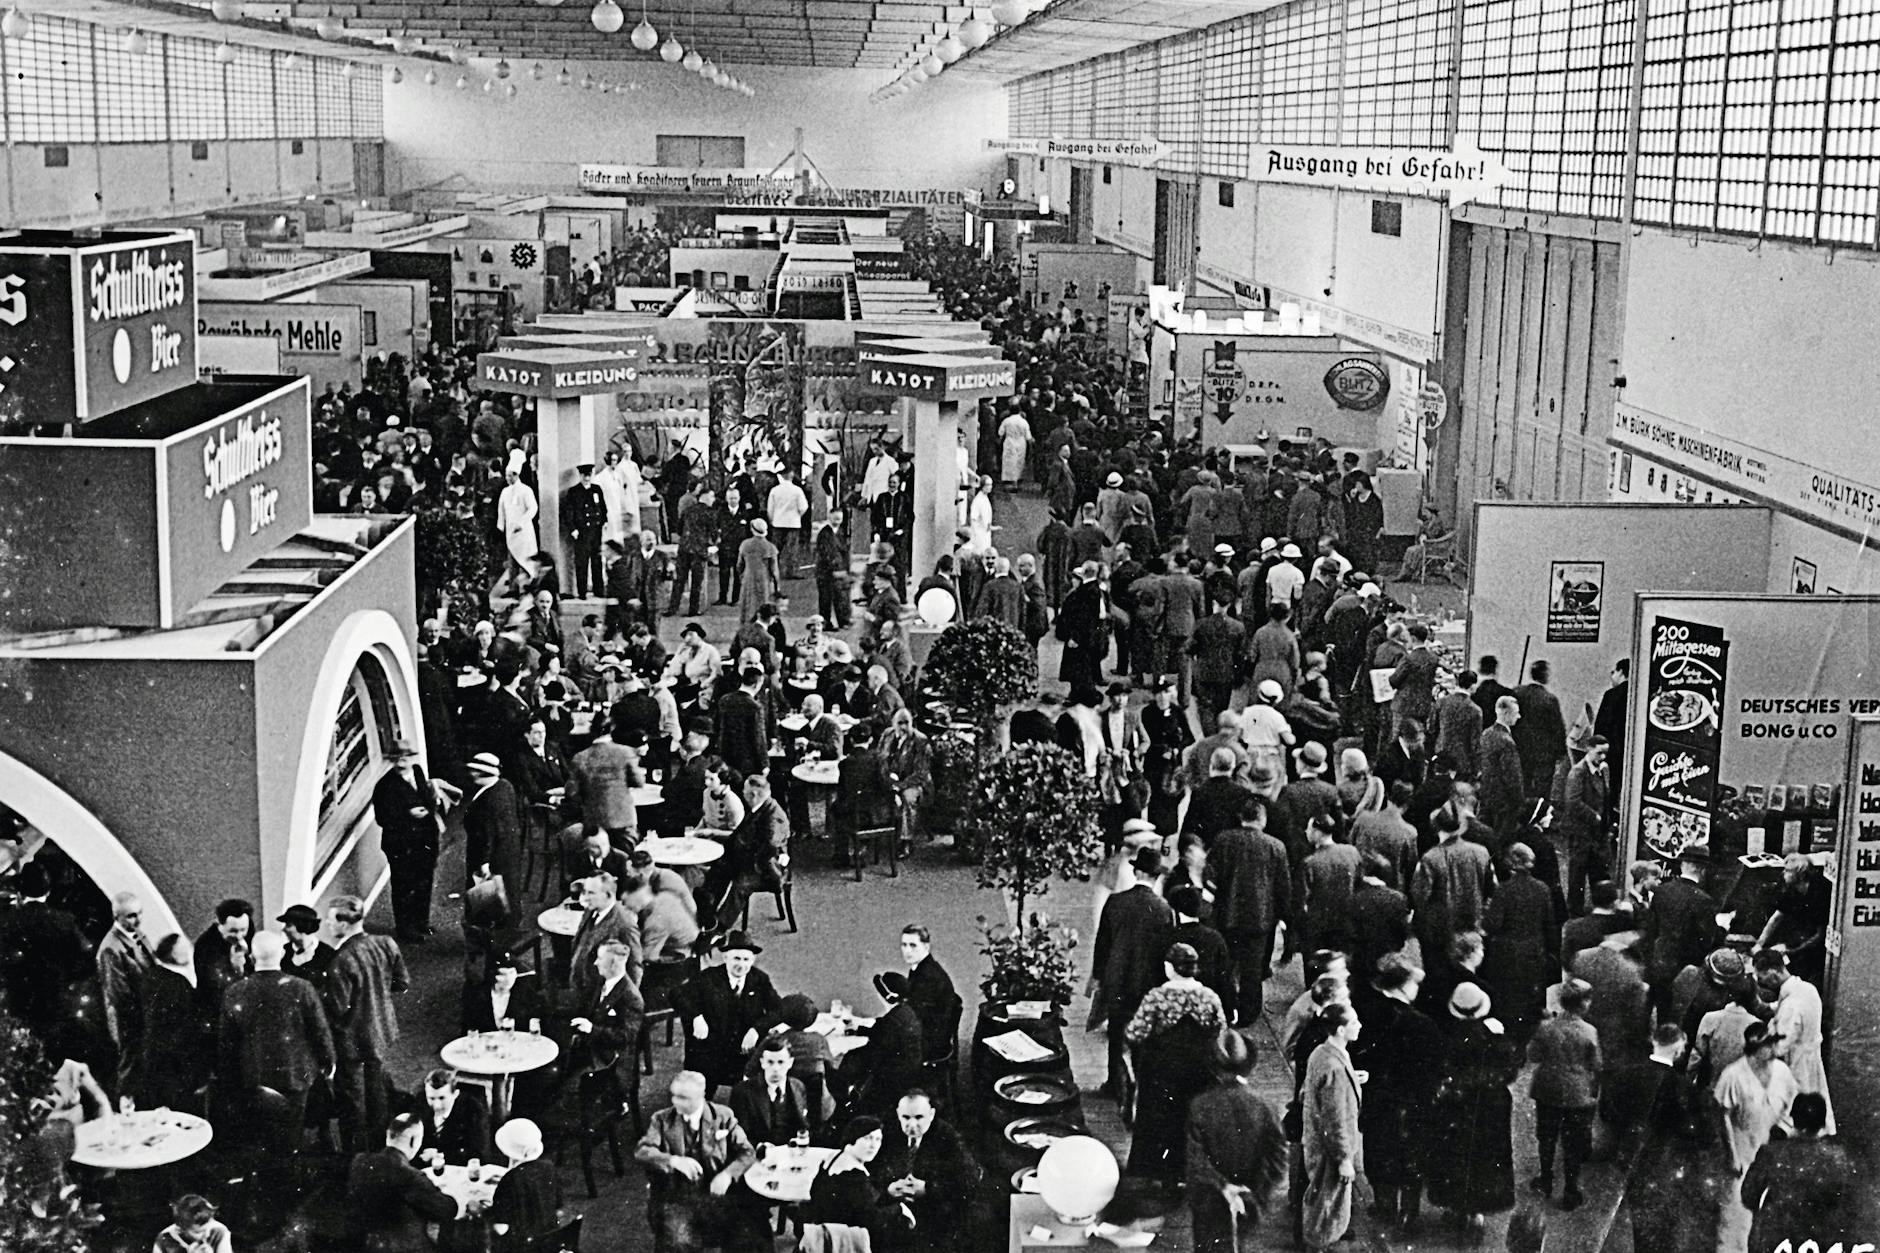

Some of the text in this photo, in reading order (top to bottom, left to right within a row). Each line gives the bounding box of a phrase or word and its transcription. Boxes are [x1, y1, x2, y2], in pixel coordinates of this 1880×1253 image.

[1049, 141, 1157, 156] Ausgang bei Gefahr!
[1268, 150, 1485, 182] Ausgang bei Gefahr!
[615, 172, 631, 185] und
[856, 258, 872, 267] Der
[287, 319, 342, 350] Mehle
[151, 324, 181, 373] Bier
[555, 367, 637, 388] KLEIDUNG
[950, 372, 1014, 392] KLEIDUNG
[1339, 376, 1375, 392] BLITZ
[1630, 415, 1651, 438] BÜRK
[1679, 434, 1744, 474] MASCHINENFABRIK
[1657, 625, 1690, 641] 200
[1653, 640, 1721, 661] Mittagessen
[1741, 698, 1840, 714] DEUTSCHES
[1741, 723, 1795, 738] BONG
[1812, 724, 1837, 738] CO
